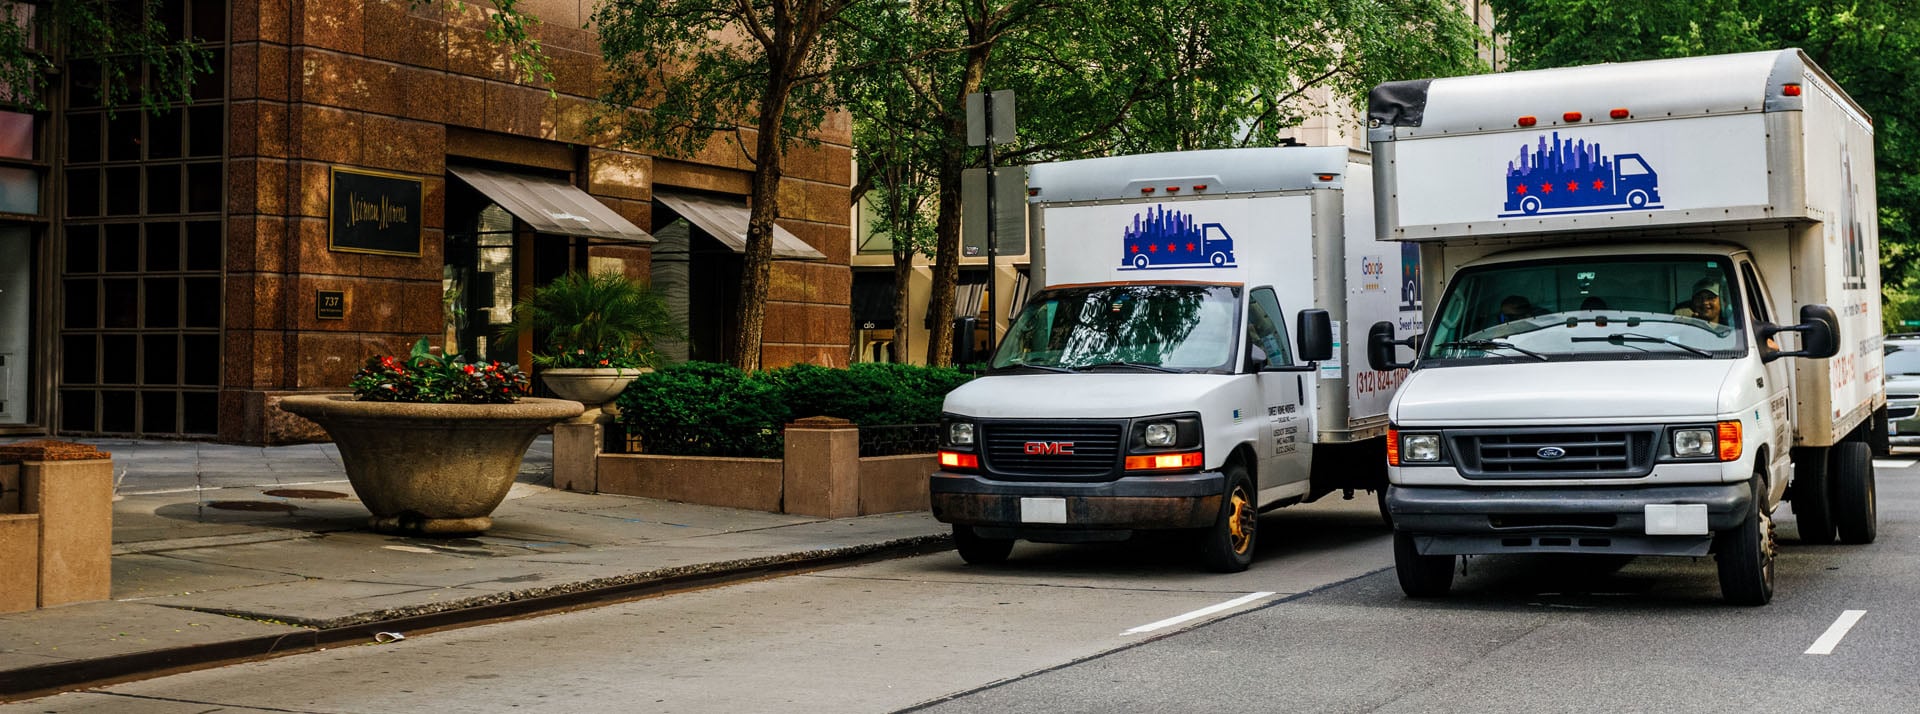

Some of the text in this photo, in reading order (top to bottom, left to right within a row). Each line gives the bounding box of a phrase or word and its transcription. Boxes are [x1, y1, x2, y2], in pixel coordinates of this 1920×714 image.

[1362, 256, 1383, 279] Google
[325, 296, 339, 306] 737
[863, 320, 875, 329] alo
[1356, 371, 1375, 400] (312)
[1023, 441, 1074, 455] GMC
